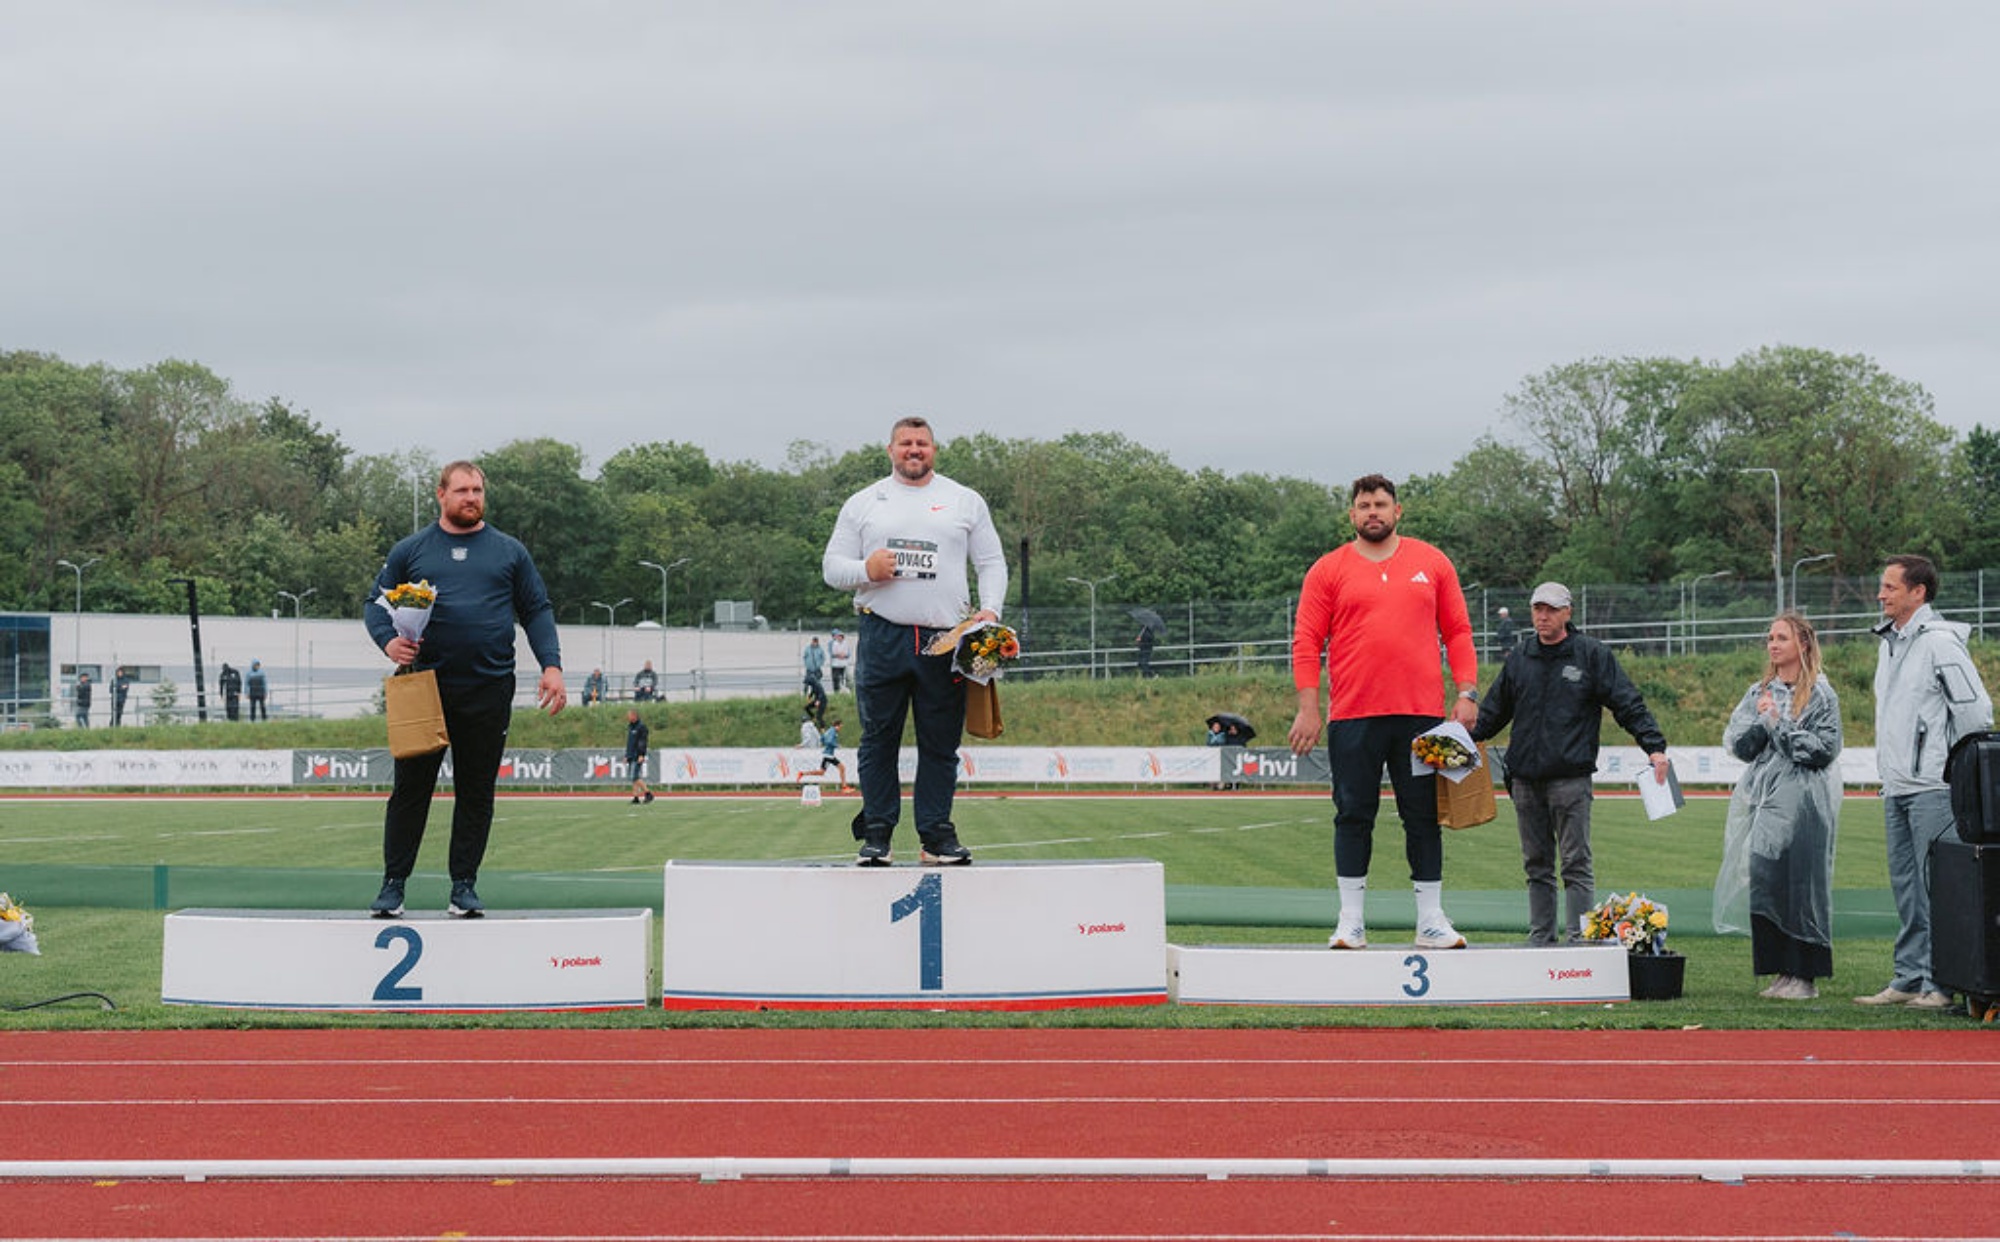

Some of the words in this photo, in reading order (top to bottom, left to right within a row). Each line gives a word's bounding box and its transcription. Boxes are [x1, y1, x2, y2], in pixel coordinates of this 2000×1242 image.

[894, 552, 933, 568] OVACS
[890, 873, 943, 990] 1
[372, 925, 423, 1000] 2
[1402, 954, 1430, 997] 3
